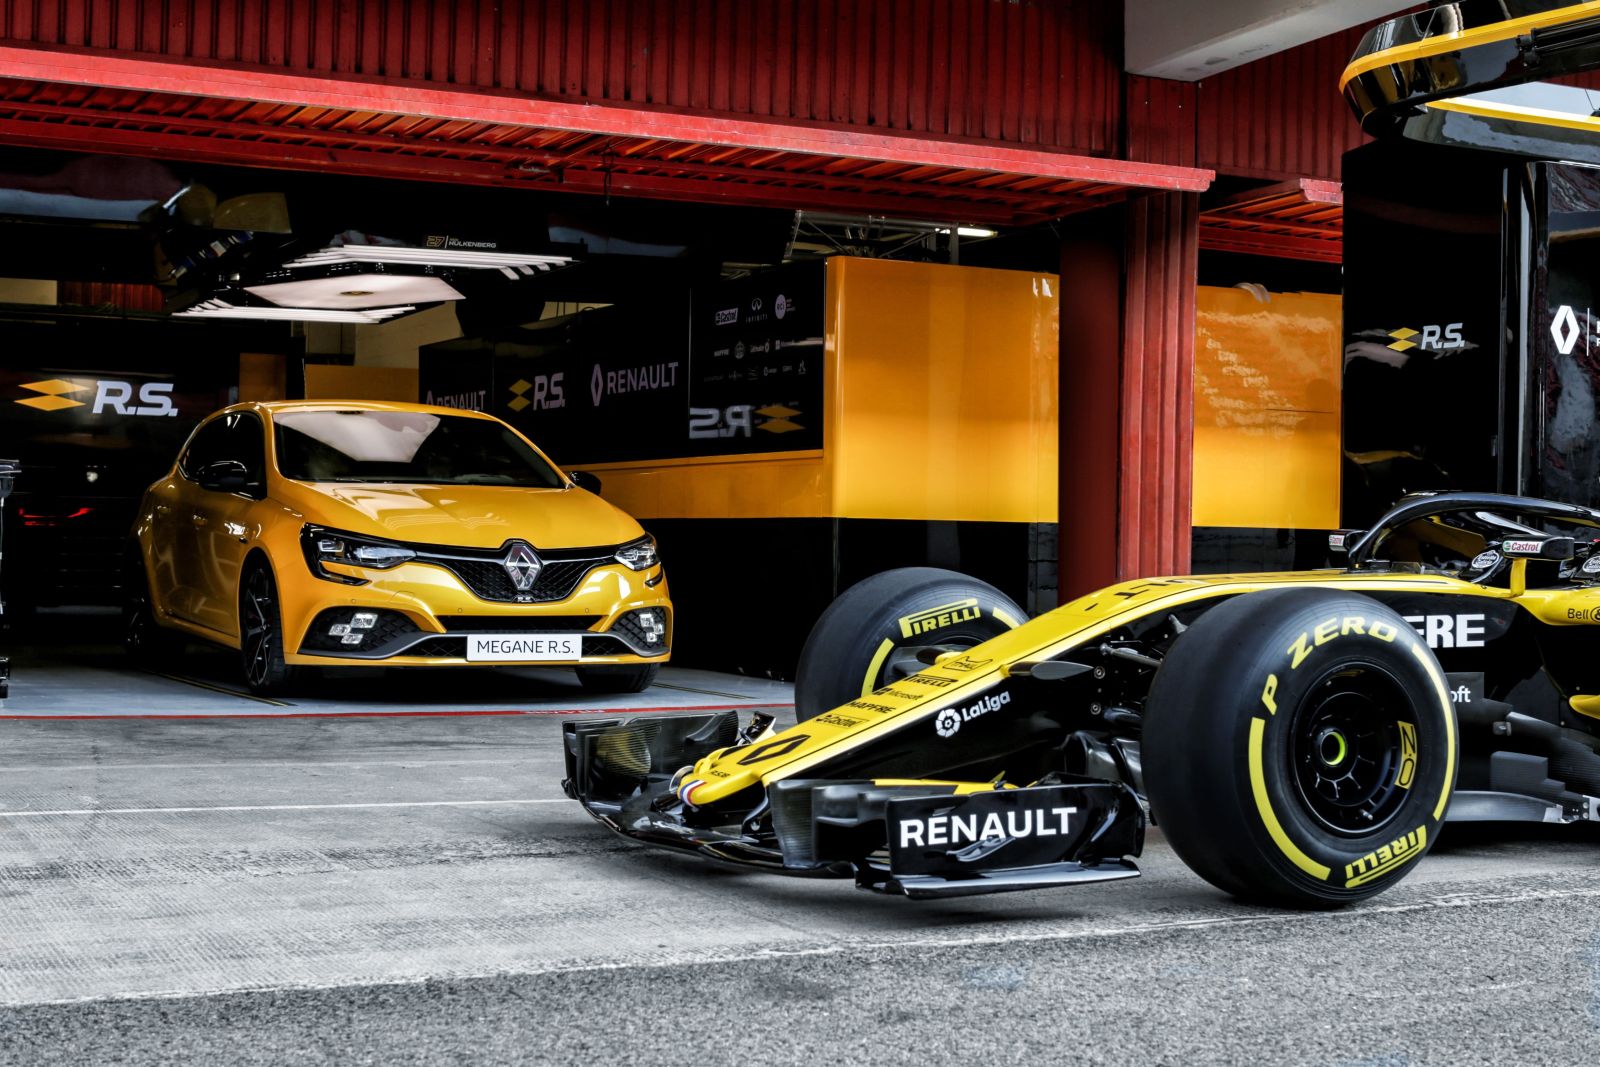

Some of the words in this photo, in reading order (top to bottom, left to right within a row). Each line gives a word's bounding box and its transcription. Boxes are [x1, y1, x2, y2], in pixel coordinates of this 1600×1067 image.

[1420, 322, 1465, 350] R.S.
[532, 372, 566, 411] R.S.
[606, 361, 679, 395] RENAULT
[92, 380, 178, 417] R.S.
[1511, 542, 1540, 552] Castrol
[898, 598, 981, 638] PIRELLI
[1568, 608, 1589, 620] Bell
[477, 640, 544, 653] MEGANE
[548, 640, 575, 653] R.S.
[903, 673, 959, 688] PIRELLI
[1261, 674, 1278, 716] P
[1286, 616, 1399, 669] ZERO
[846, 701, 896, 714] MAPFRE
[961, 691, 1011, 722] LaLiga
[899, 807, 1078, 848] RENAULT
[1345, 825, 1427, 889] PIRELLI
